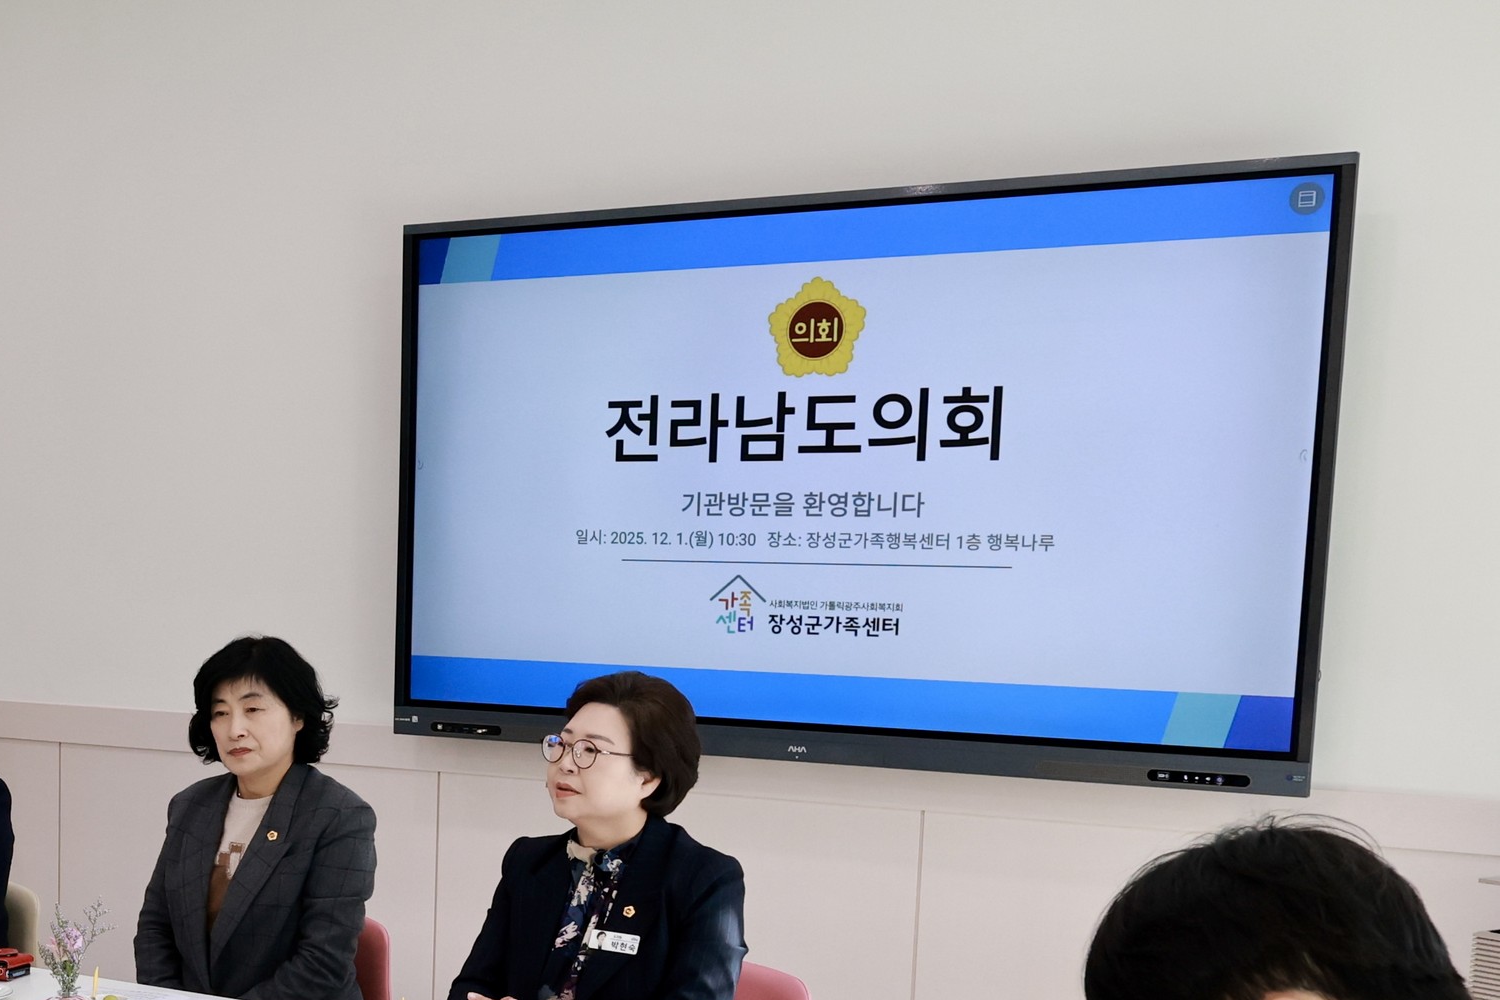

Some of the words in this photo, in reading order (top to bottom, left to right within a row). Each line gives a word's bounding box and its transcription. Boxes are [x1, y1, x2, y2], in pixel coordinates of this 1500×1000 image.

[791, 317, 839, 343] 의회
[605, 386, 1004, 463] 전라남도의회
[682, 491, 795, 517] 기관방문을
[803, 491, 925, 518] 환영합니다
[575, 529, 607, 545] 일시:
[610, 531, 647, 545] 2025.
[652, 531, 672, 545] 12.
[677, 530, 714, 549] 1.(월)
[718, 532, 756, 546] 10:30
[767, 531, 802, 548] 장소:
[806, 531, 951, 550] 장성군가족행복센터
[956, 533, 982, 551] 1층
[987, 533, 1056, 552] 행복나루
[769, 599, 818, 610] 사회복지법인
[768, 614, 900, 637] 장성군가족센터
